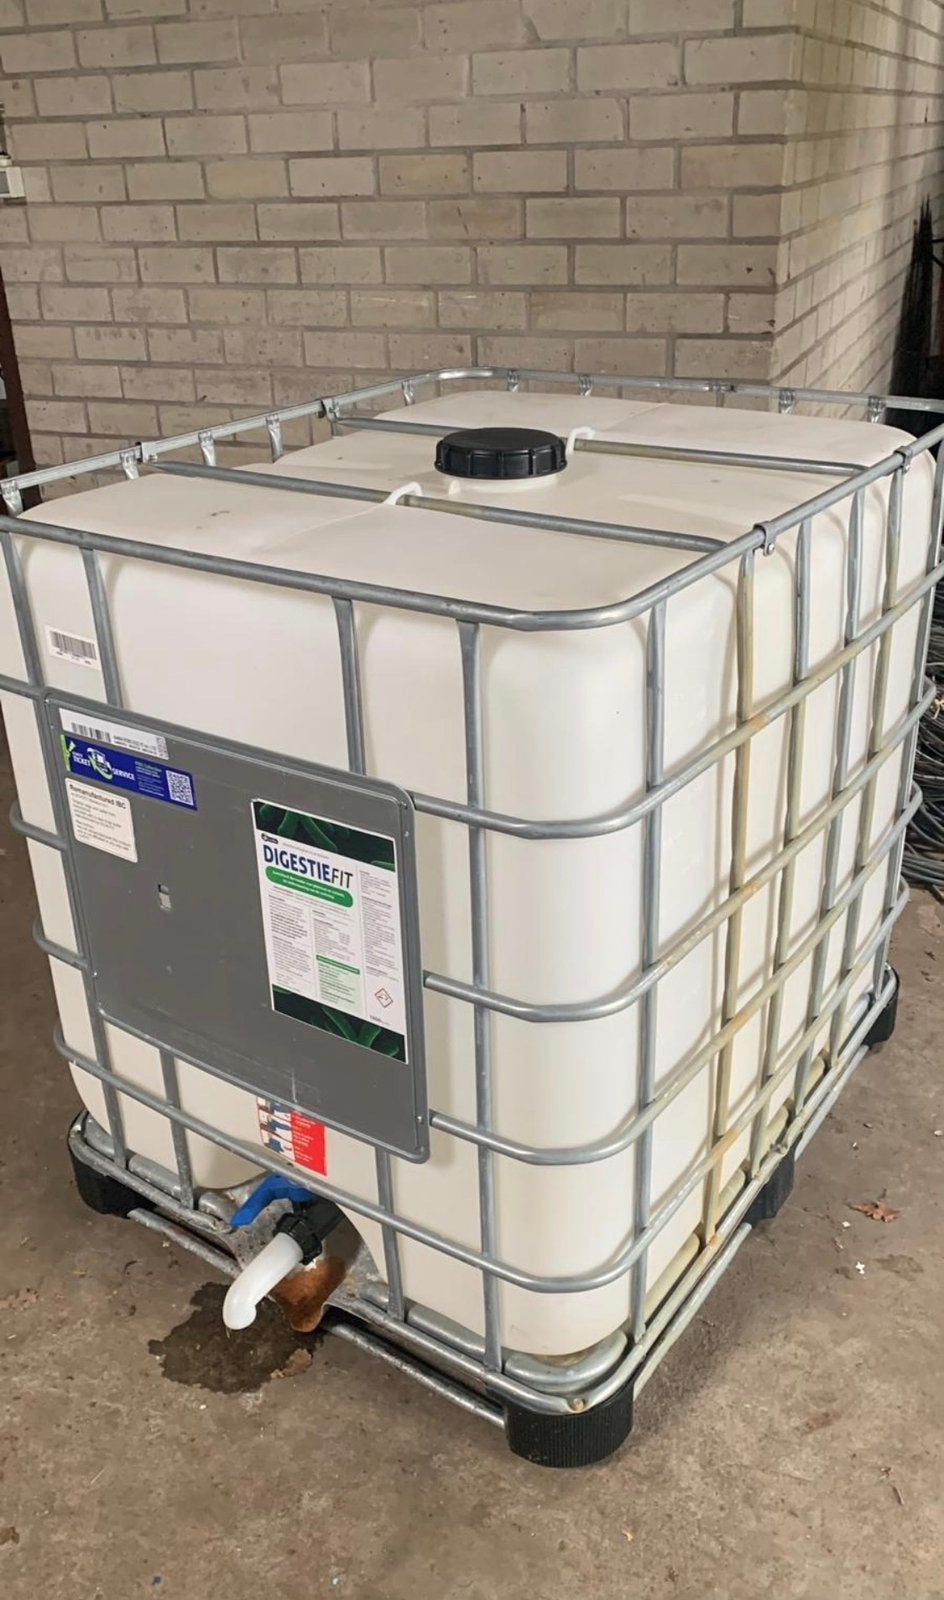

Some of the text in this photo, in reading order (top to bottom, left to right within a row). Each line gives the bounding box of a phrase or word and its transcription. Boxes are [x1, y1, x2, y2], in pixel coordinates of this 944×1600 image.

[73, 756, 91, 767] TICKET
[112, 767, 136, 780] SERVICE
[69, 784, 114, 805] Remanufactured
[115, 800, 126, 809] IBC
